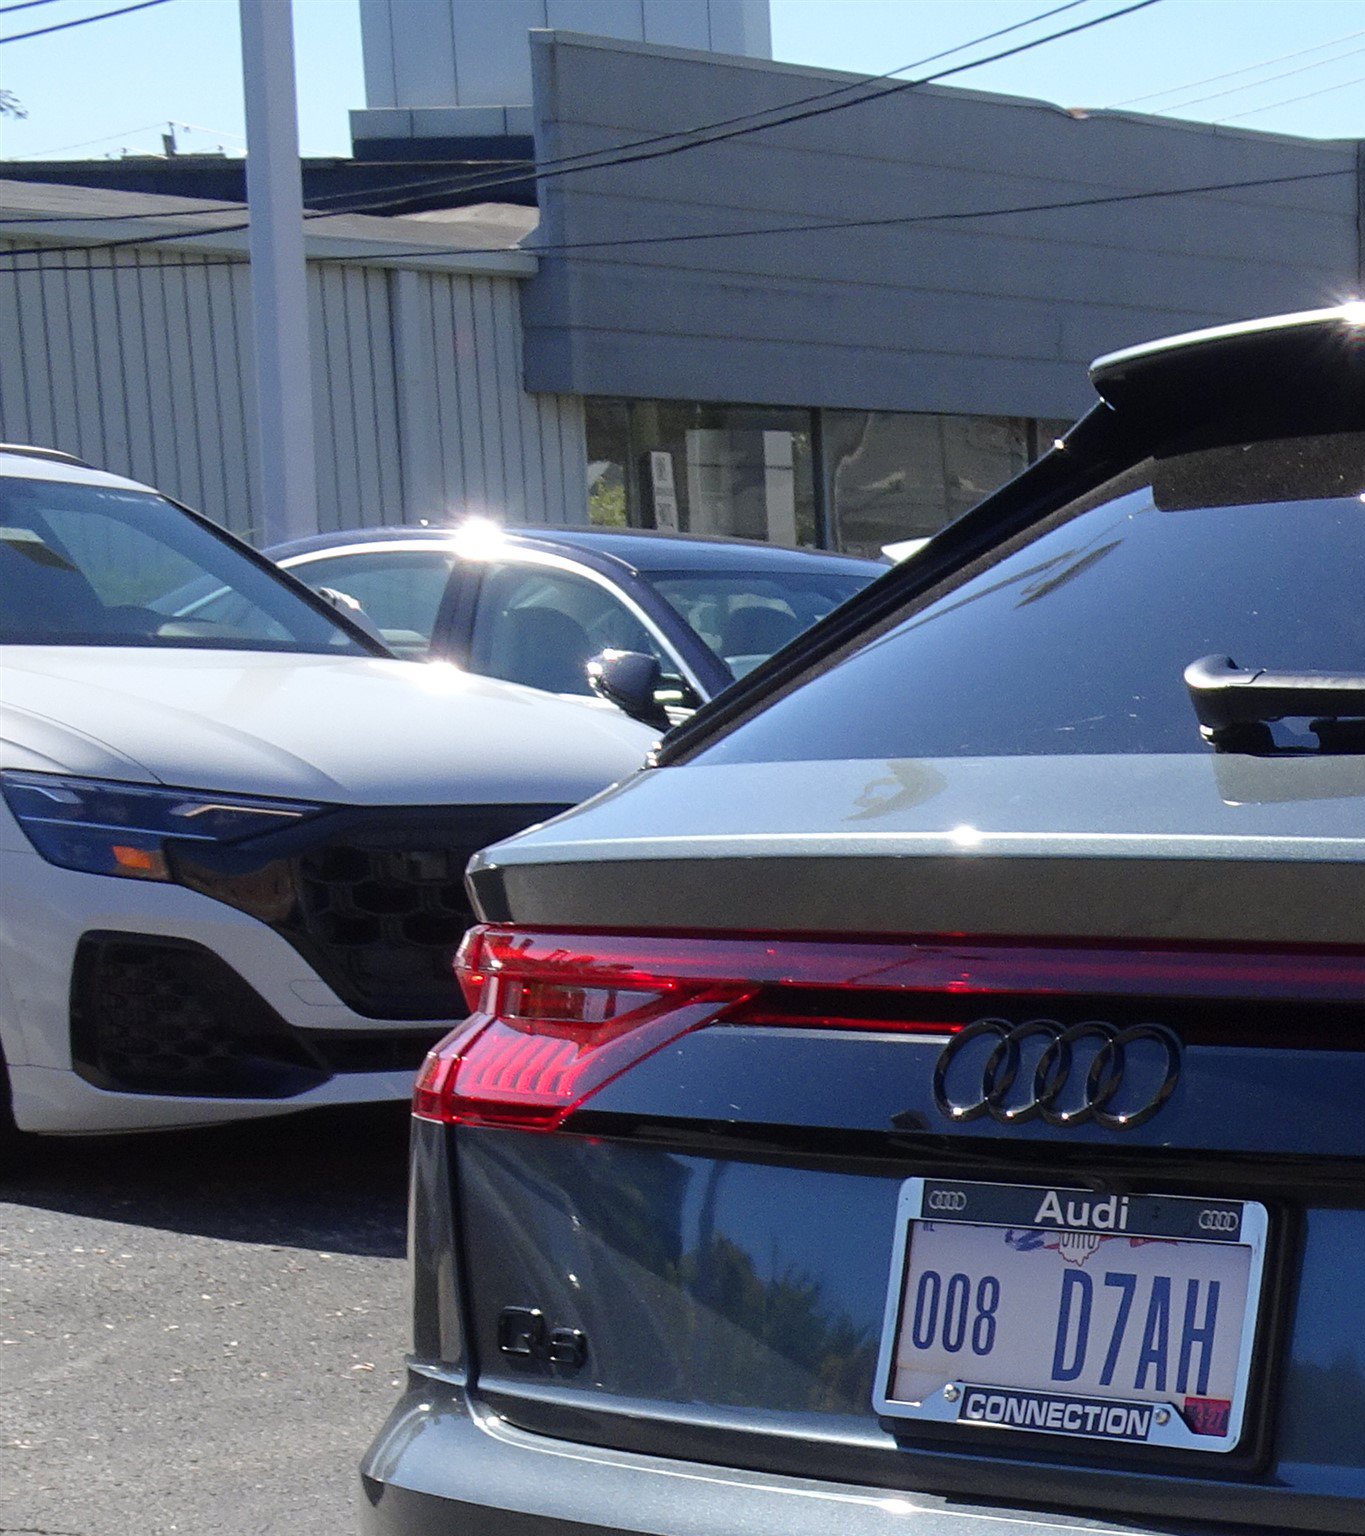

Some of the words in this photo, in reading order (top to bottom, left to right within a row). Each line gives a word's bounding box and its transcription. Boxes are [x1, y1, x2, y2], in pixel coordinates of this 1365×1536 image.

[1034, 1190, 1130, 1231] Audi
[911, 1270, 1001, 1357] 008
[1051, 1268, 1221, 1397] D7AH
[965, 1393, 1151, 1438] CONNECTION
